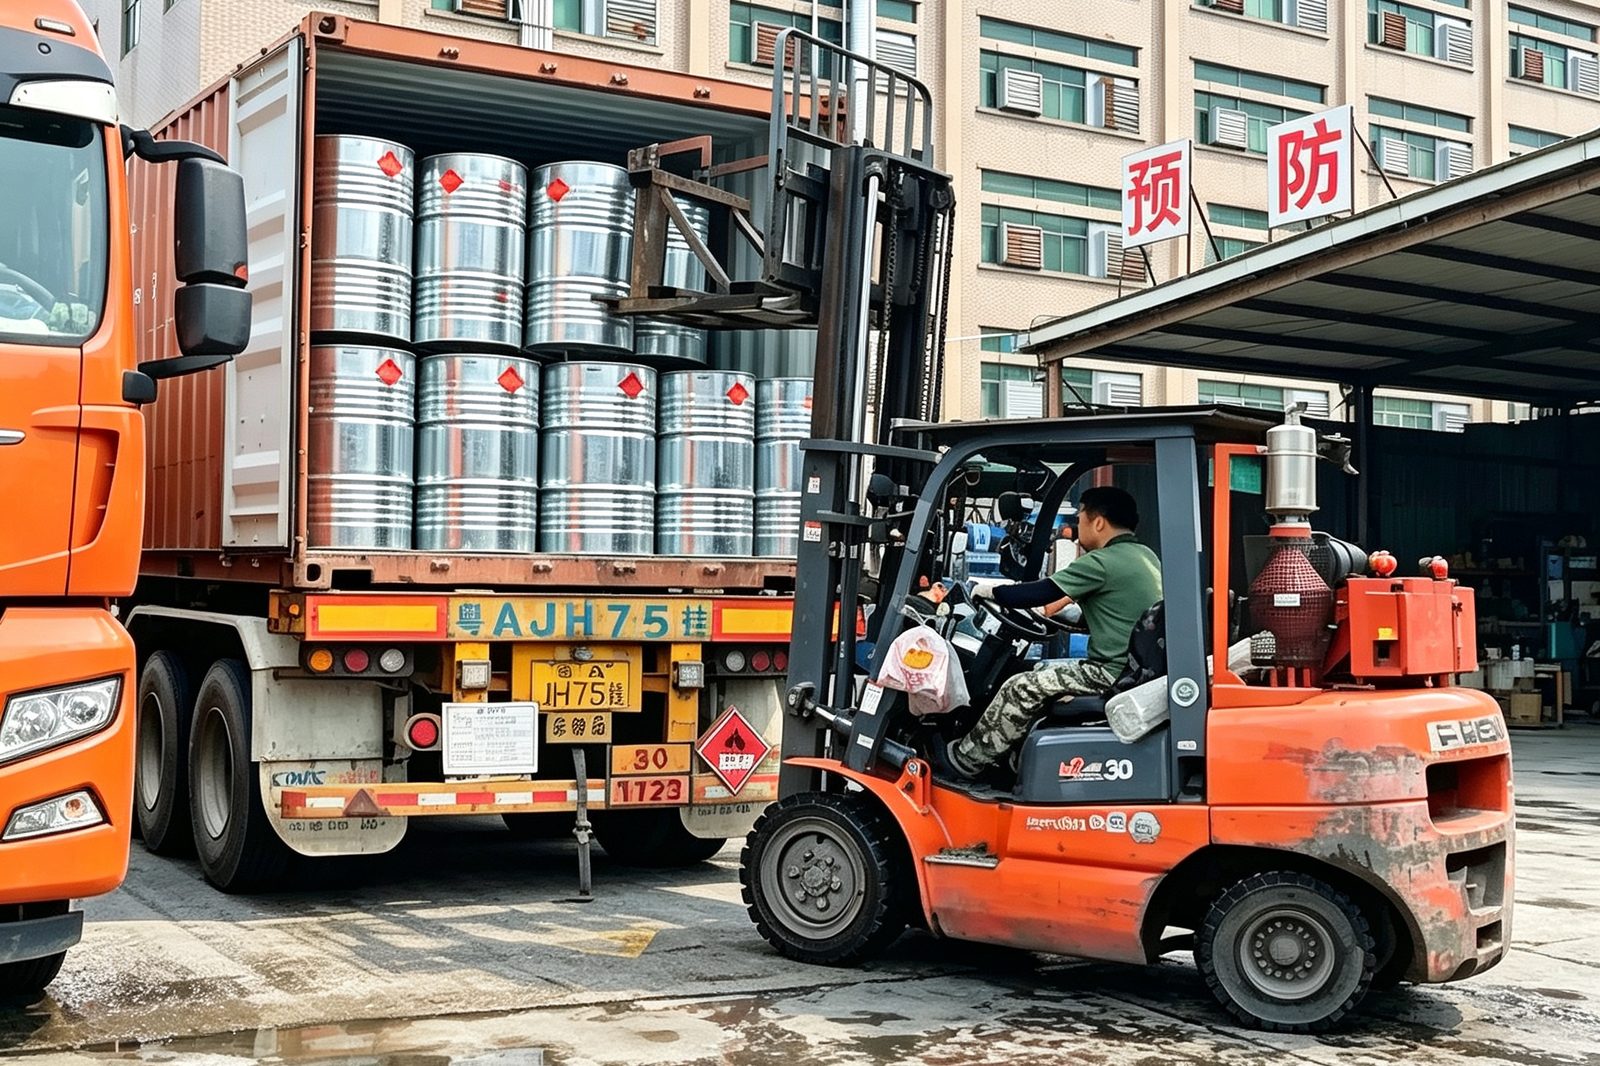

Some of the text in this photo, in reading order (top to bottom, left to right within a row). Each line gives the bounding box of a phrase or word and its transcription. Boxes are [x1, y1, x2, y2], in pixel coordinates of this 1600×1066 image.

[1127, 150, 1182, 237] 预
[1278, 118, 1342, 214] 防
[633, 747, 668, 771] 30
[1103, 758, 1134, 781] 30
